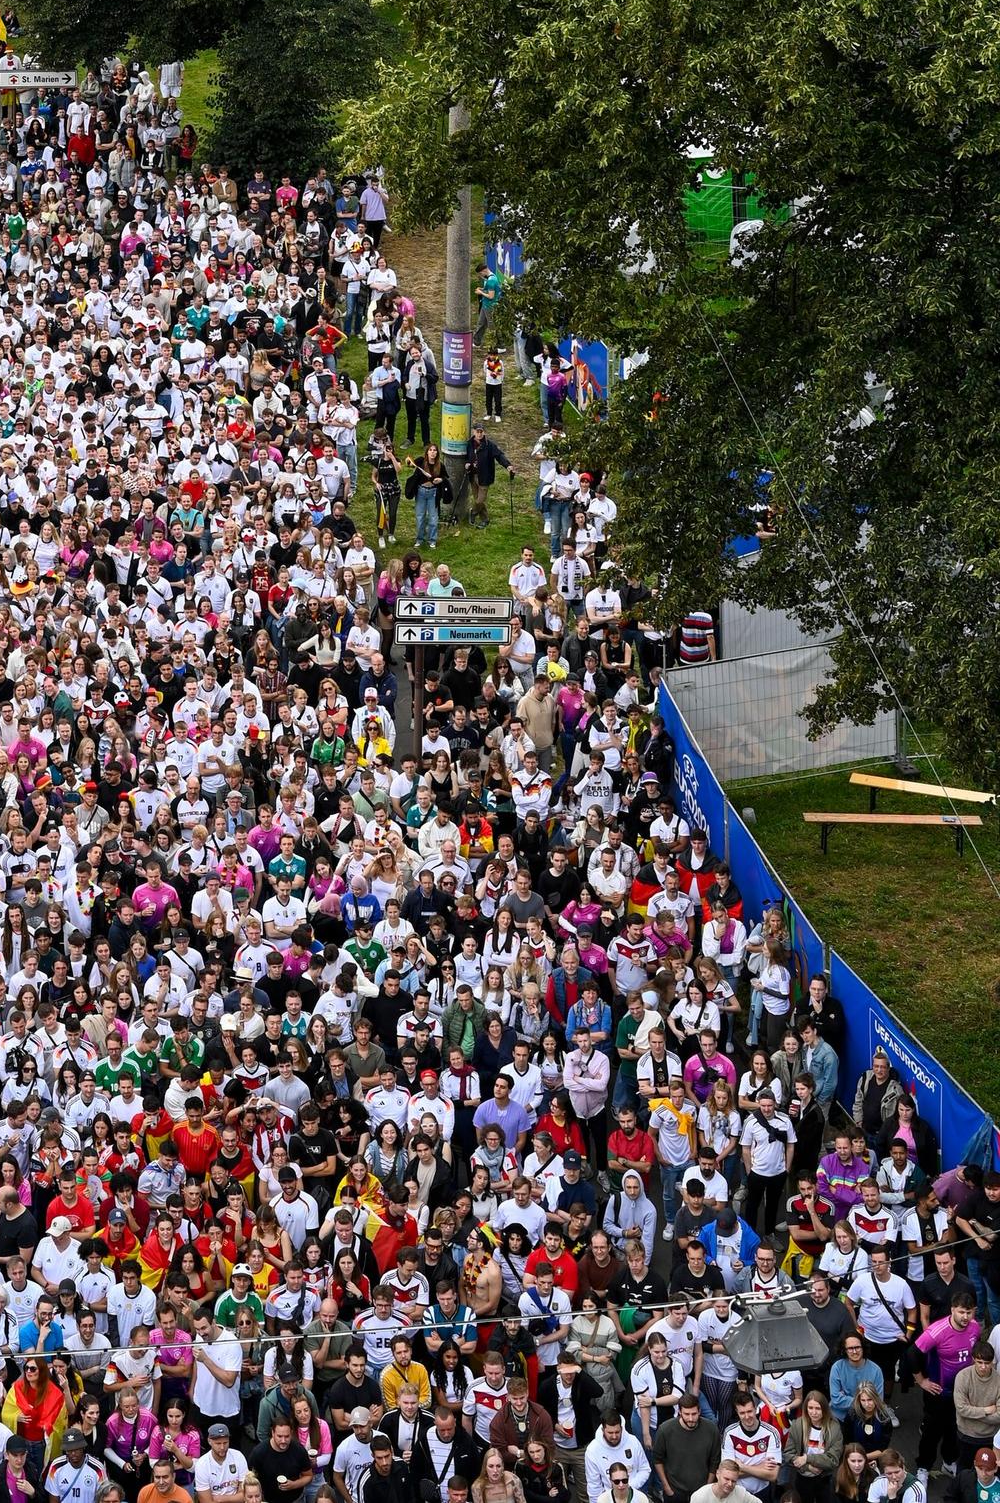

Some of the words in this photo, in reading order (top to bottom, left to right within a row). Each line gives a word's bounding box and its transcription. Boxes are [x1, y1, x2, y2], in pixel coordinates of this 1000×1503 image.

[425, 606, 431, 614] P
[447, 604, 496, 615] Dom/Rhein
[424, 632, 431, 640] P
[449, 630, 491, 639] Neumarkt
[256, 963, 262, 972] 8
[958, 1350, 968, 1362] 17
[72, 1487, 80, 1498] 10
